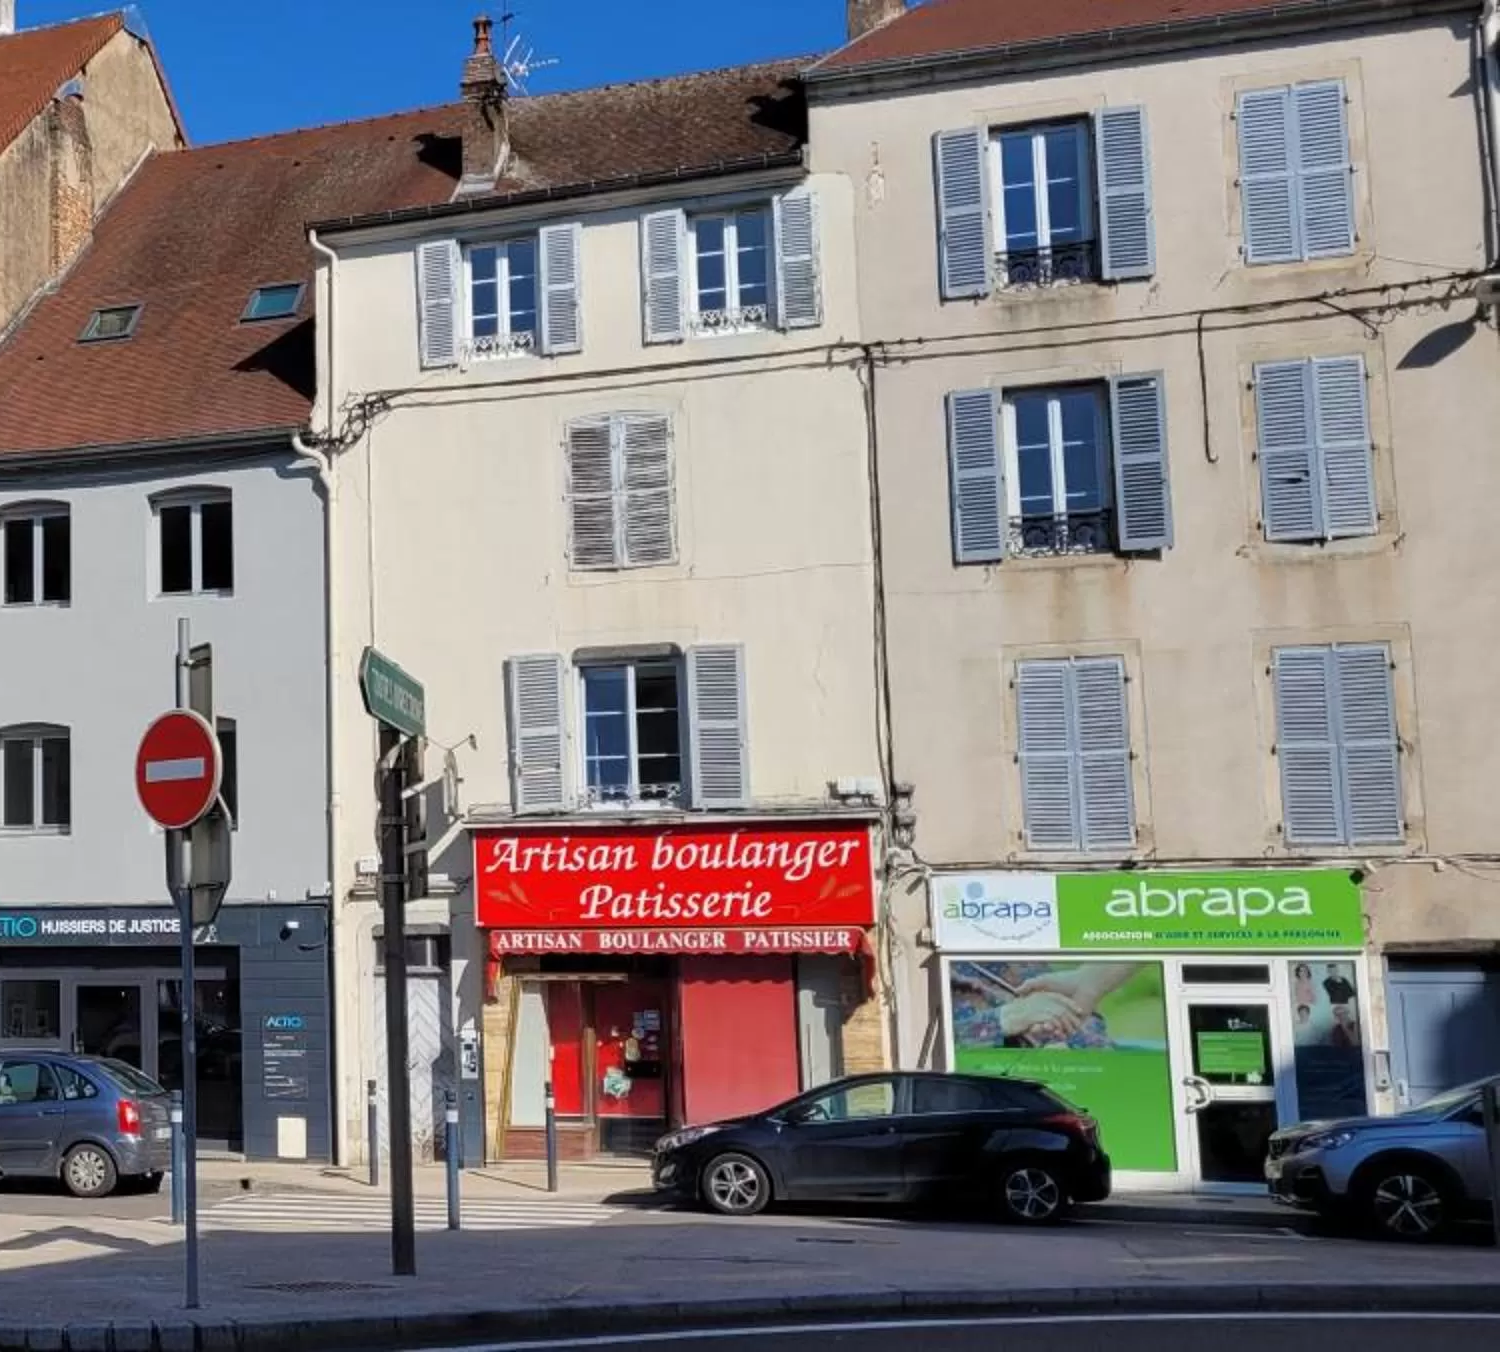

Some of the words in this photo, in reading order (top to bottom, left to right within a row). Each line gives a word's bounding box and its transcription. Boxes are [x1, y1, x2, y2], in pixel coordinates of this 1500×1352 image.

[484, 837, 639, 875] Artisan
[650, 827, 861, 882] boulanger
[578, 880, 773, 920] Patisserie
[942, 899, 1052, 924] abrapa
[1104, 880, 1313, 927] abrapa
[41, 919, 106, 934] HUISSIERS
[109, 919, 126, 933] DE
[128, 918, 181, 934] JUSTICE
[497, 932, 583, 949] ARTISAN
[599, 931, 726, 949] BOULANGER
[743, 930, 852, 948] PATISSIER
[265, 1015, 303, 1028] ACTIO
